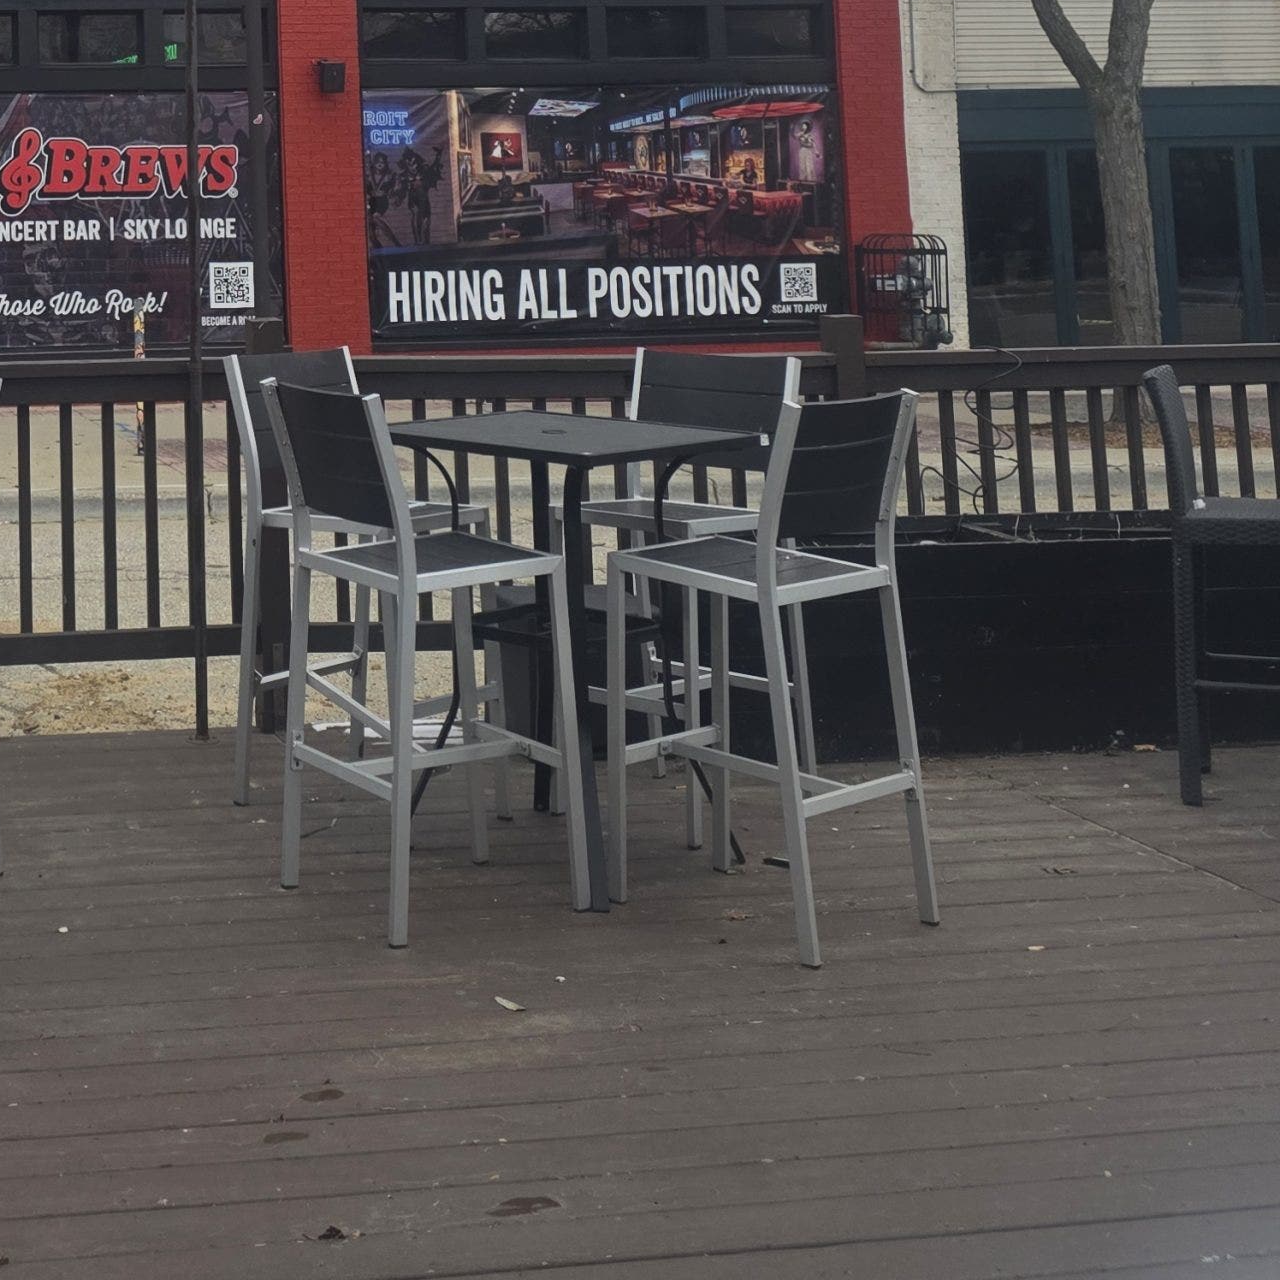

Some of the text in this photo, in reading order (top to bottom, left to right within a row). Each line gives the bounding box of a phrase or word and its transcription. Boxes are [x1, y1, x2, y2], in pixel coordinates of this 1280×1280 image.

[370, 129, 415, 145] CITY
[38, 136, 238, 200] BREWS
[63, 219, 101, 241] BAR
[124, 219, 160, 239] SKY
[164, 218, 237, 239] LONGE
[49, 290, 102, 316] Who
[105, 288, 168, 321] Rok!
[389, 264, 762, 322] HIRING ALL POSITIONS
[771, 303, 828, 314] SCAN TO APPLY
[201, 315, 231, 327] BECOME
[231, 315, 238, 326] A
